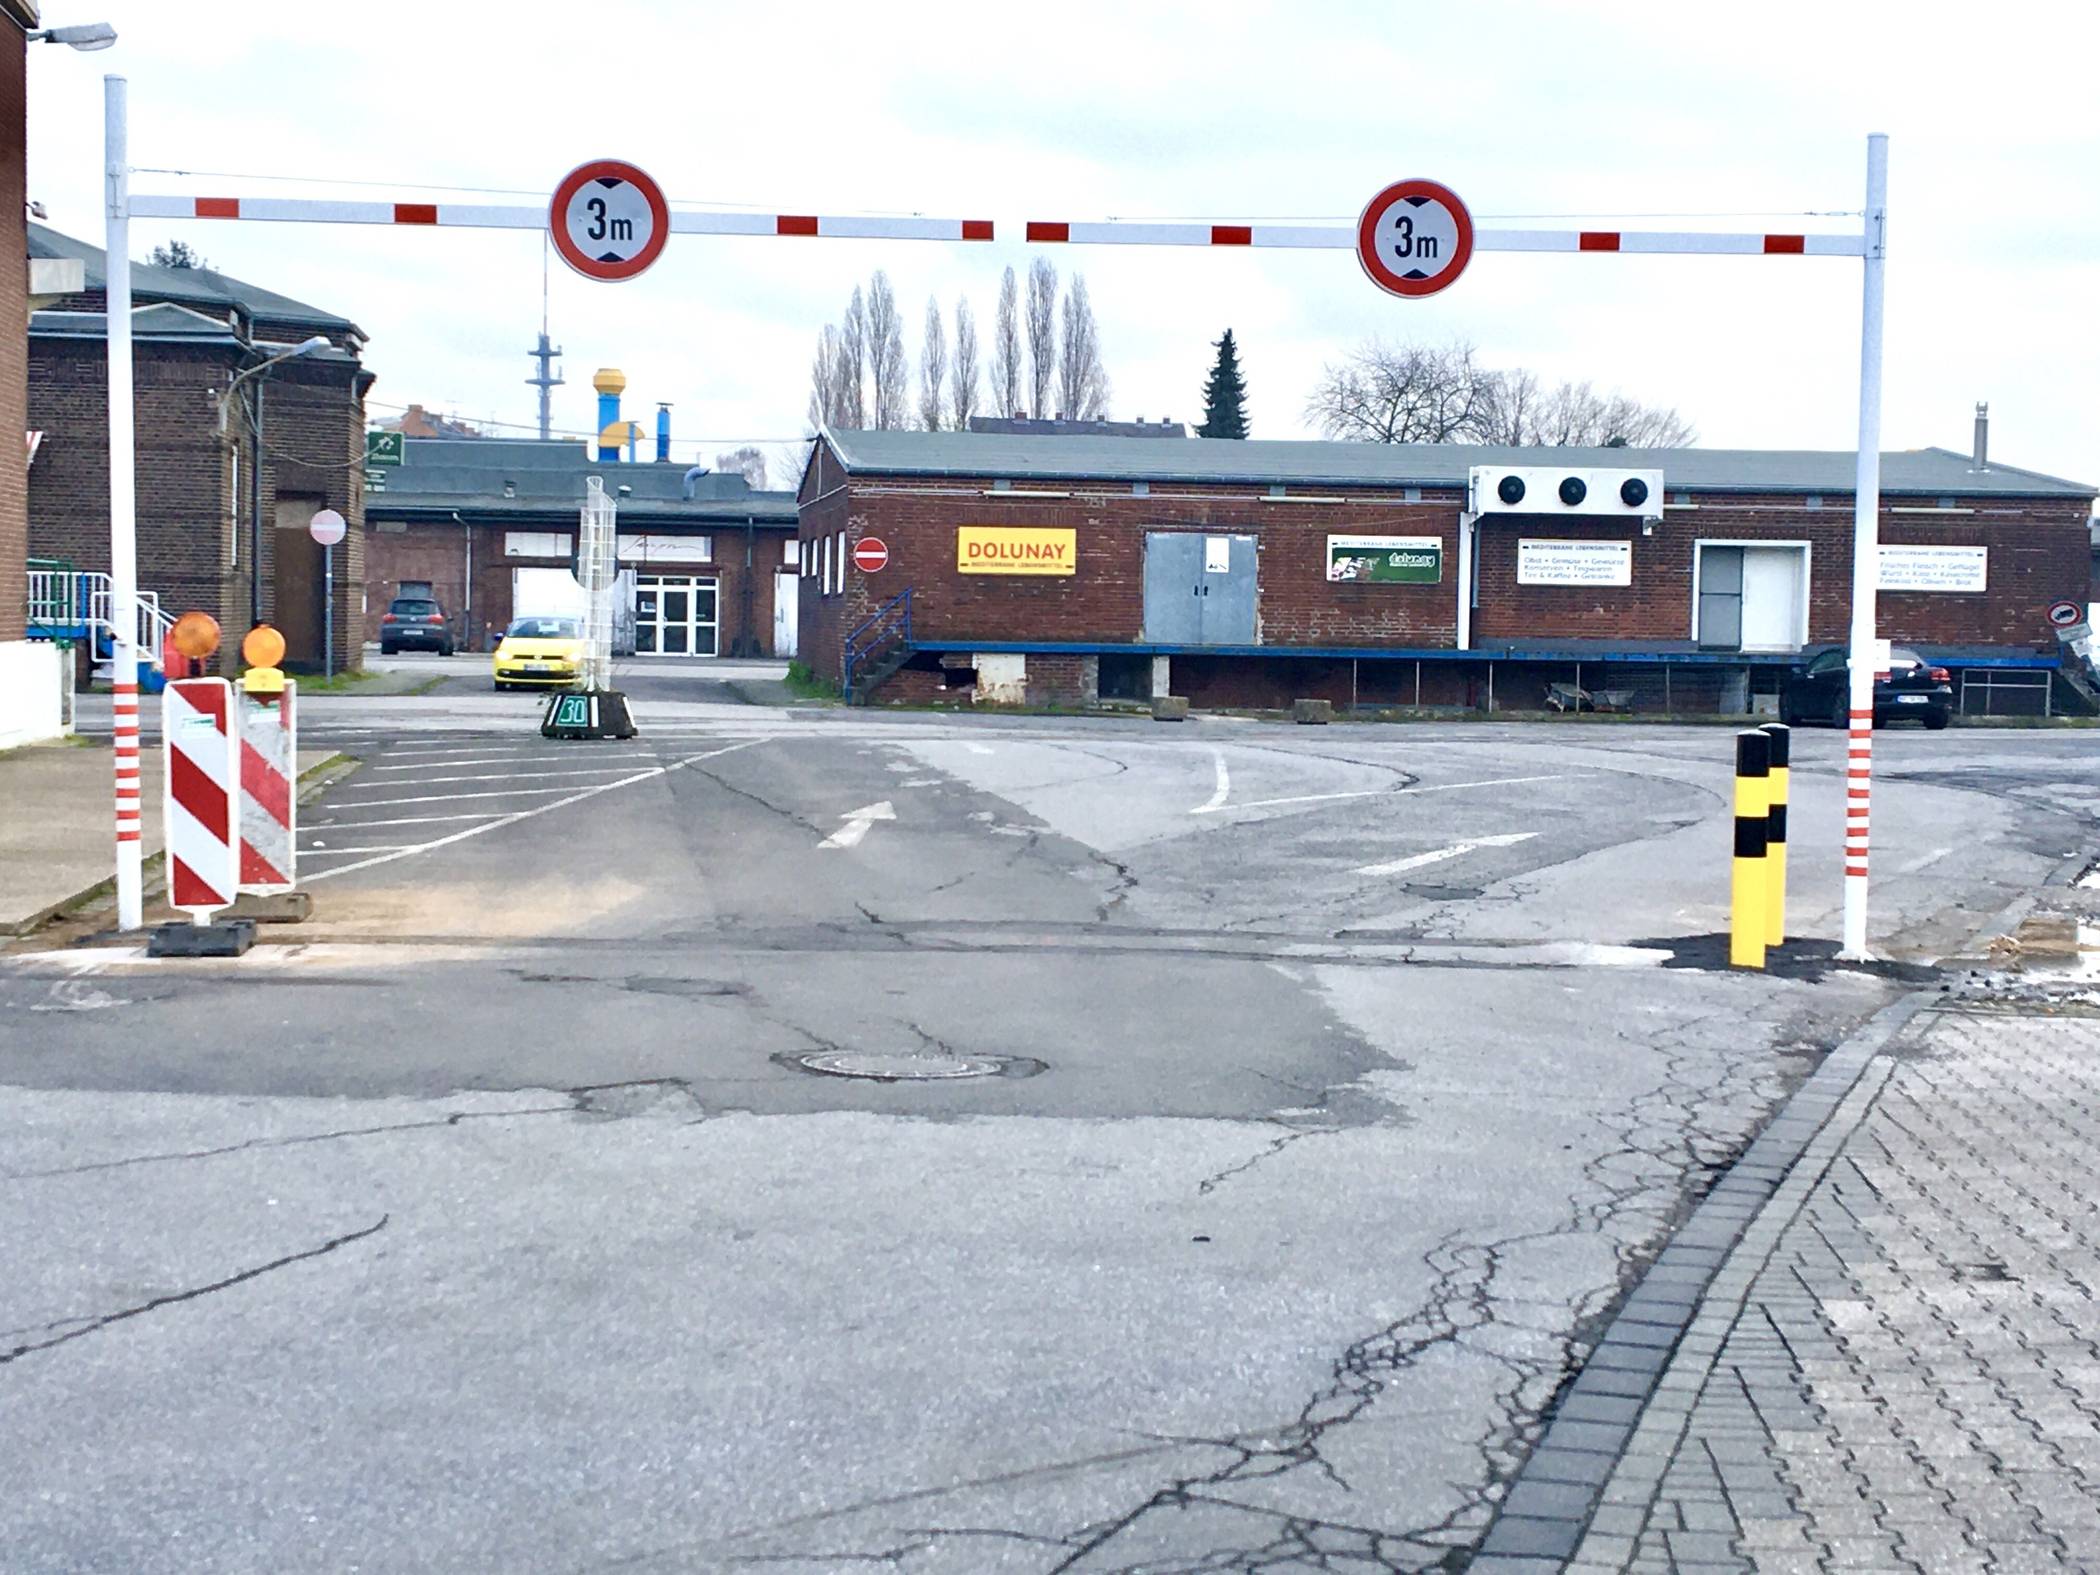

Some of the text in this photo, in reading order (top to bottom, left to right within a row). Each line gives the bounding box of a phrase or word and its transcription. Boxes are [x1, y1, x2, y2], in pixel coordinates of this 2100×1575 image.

[967, 541, 1066, 560] DOLUNAY
[1387, 551, 1437, 568] dolunay
[560, 699, 586, 723] 30
